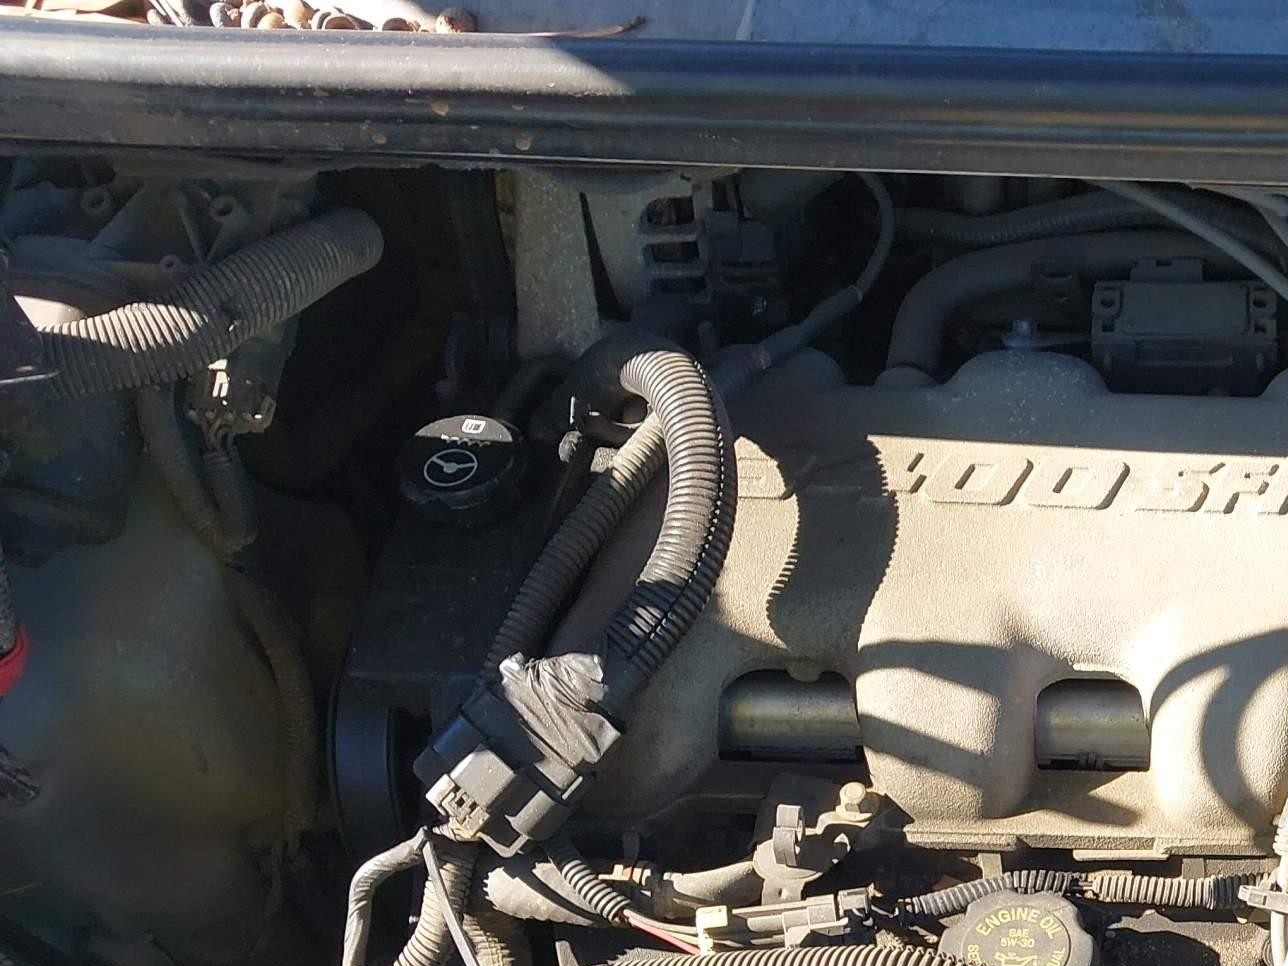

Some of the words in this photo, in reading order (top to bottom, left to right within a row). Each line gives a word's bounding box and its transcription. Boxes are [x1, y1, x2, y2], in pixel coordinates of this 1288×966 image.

[976, 907, 1041, 936] ENGINE
[1039, 916, 1062, 939] OIL
[1008, 929, 1029, 937] SAE
[1000, 937, 1036, 948] 5W-30
